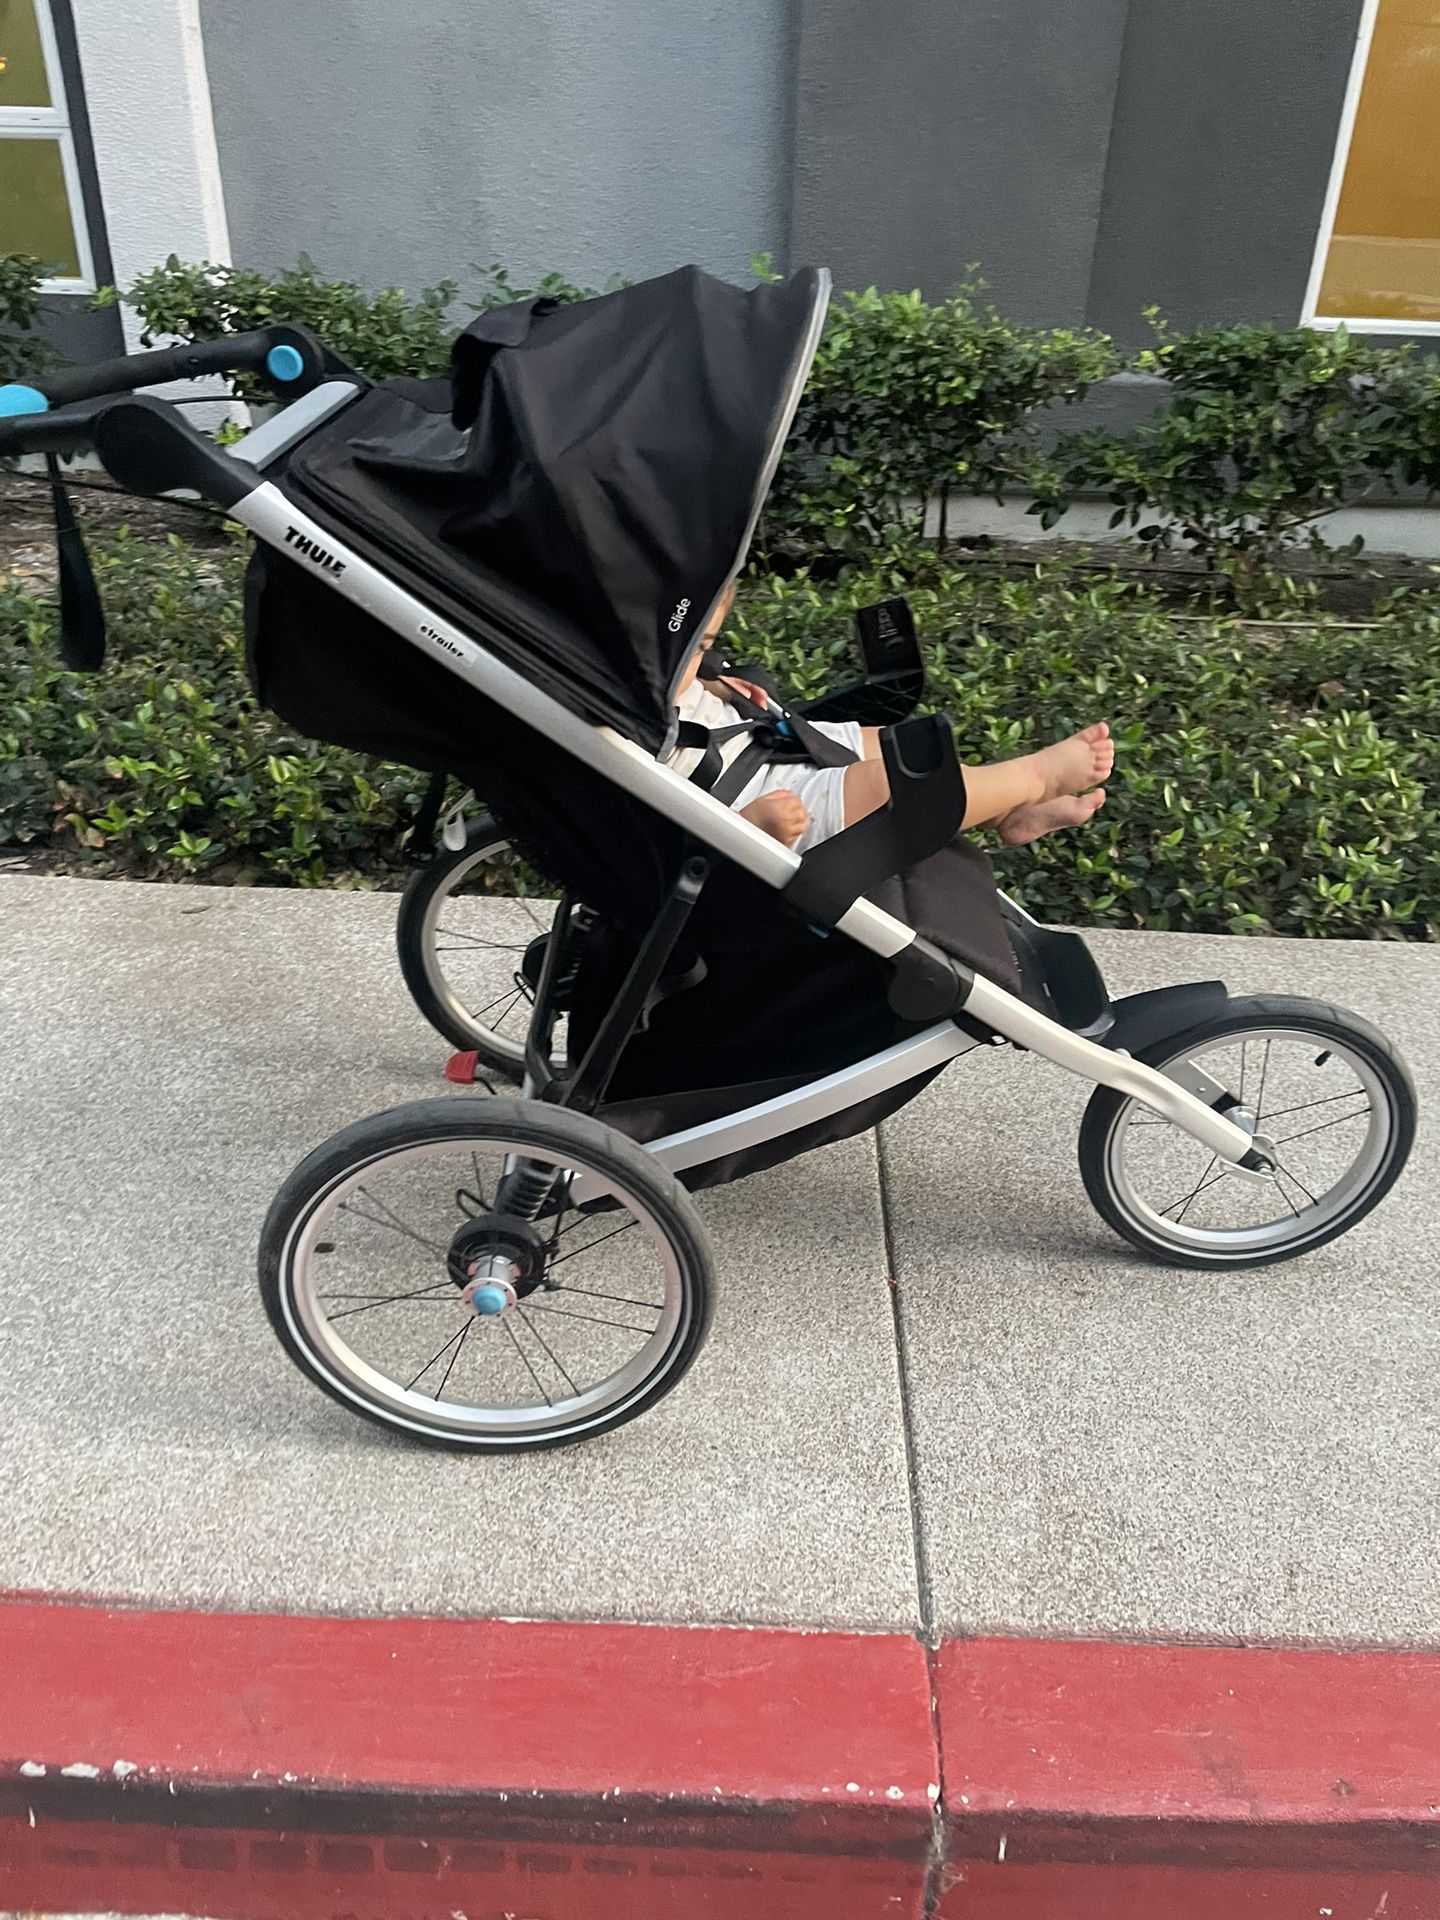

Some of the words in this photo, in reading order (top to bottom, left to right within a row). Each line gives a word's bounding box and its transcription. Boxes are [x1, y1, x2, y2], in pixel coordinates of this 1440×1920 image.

[285, 525, 347, 578] THULE
[667, 598, 691, 632] Glide
[420, 625, 464, 657] etrailer
